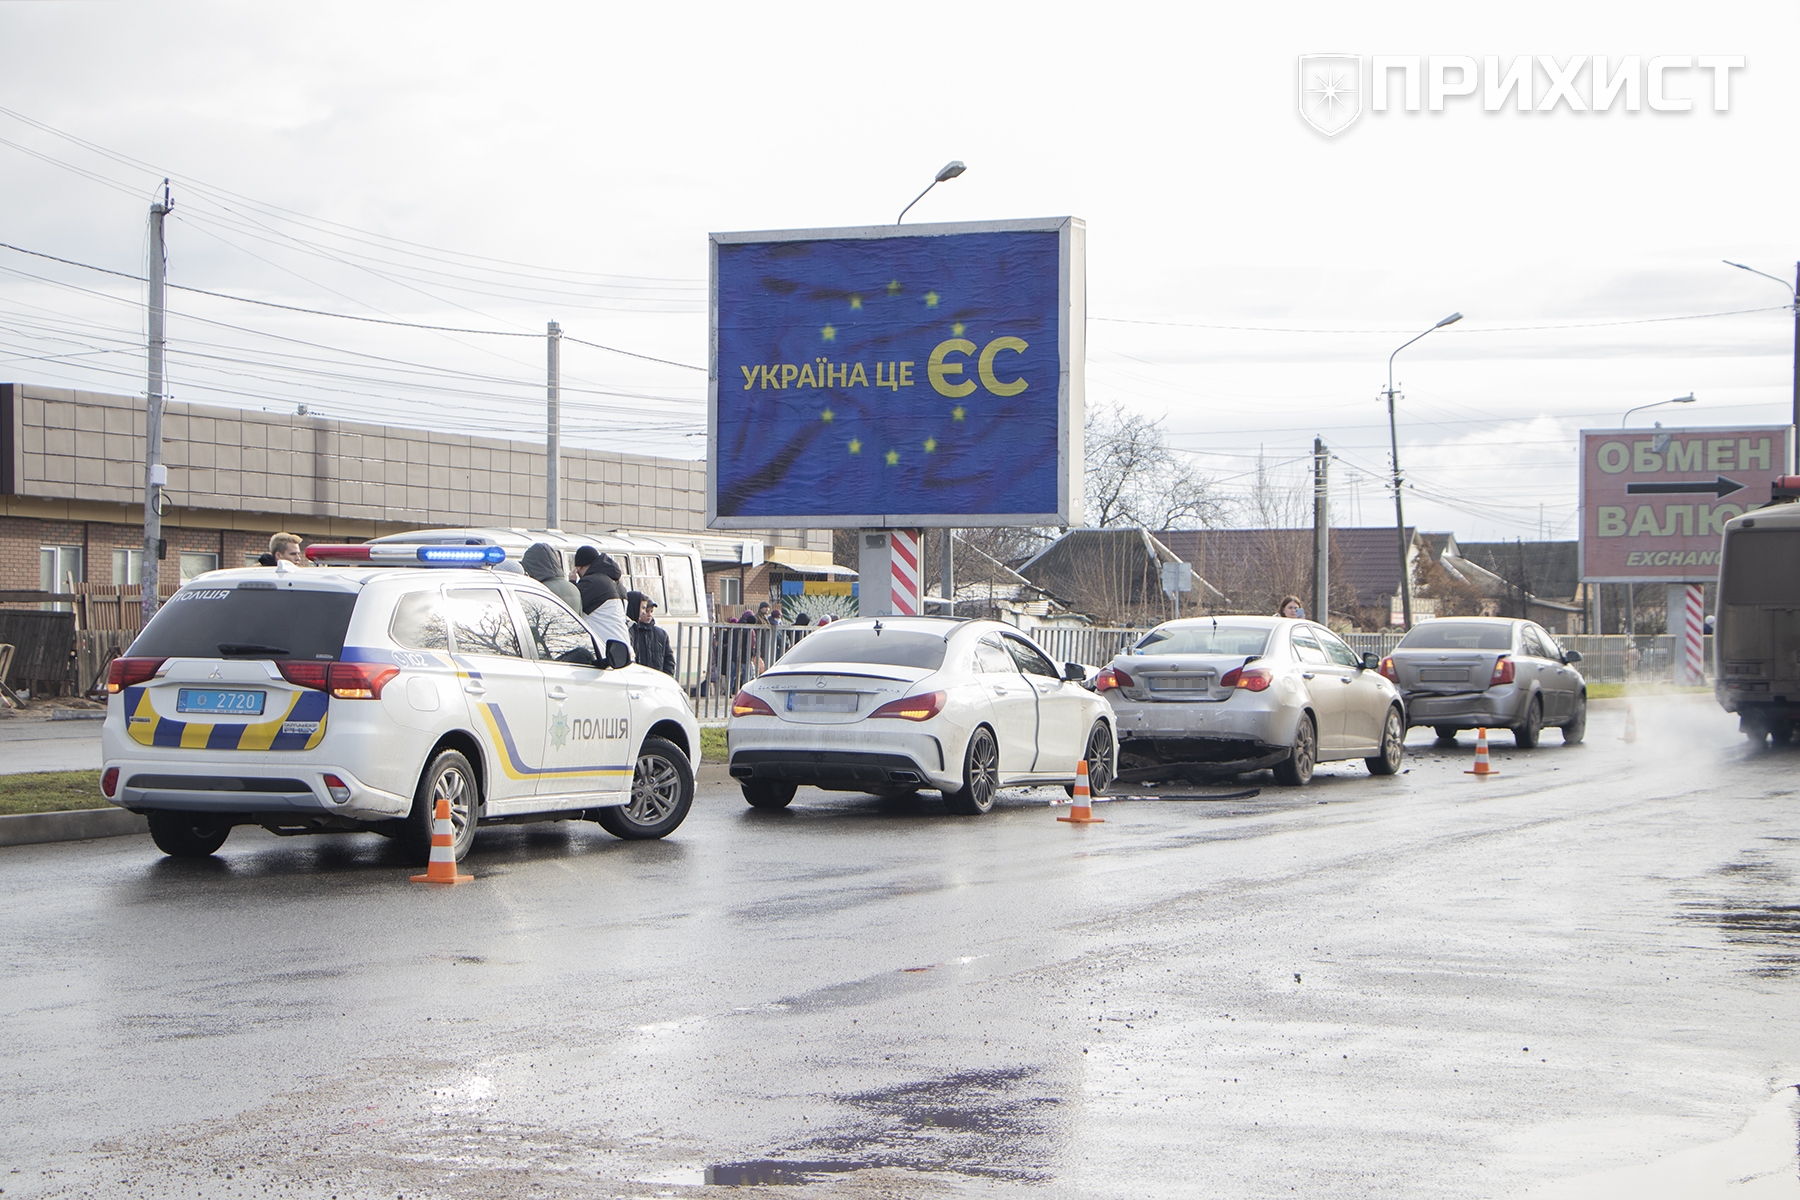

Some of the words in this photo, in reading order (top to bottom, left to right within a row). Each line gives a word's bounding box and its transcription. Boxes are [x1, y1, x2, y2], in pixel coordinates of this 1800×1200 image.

[740, 356, 870, 391] УКРАЇНА
[875, 360, 916, 392] ЦЕ
[926, 335, 1030, 399] ЄС
[1597, 437, 1773, 475] ОБМЕН
[170, 589, 231, 604] ПОЛІЦІЯ
[404, 652, 429, 668] 102
[216, 693, 256, 710] 2720
[571, 717, 629, 741] ПОЛІЦІЯ
